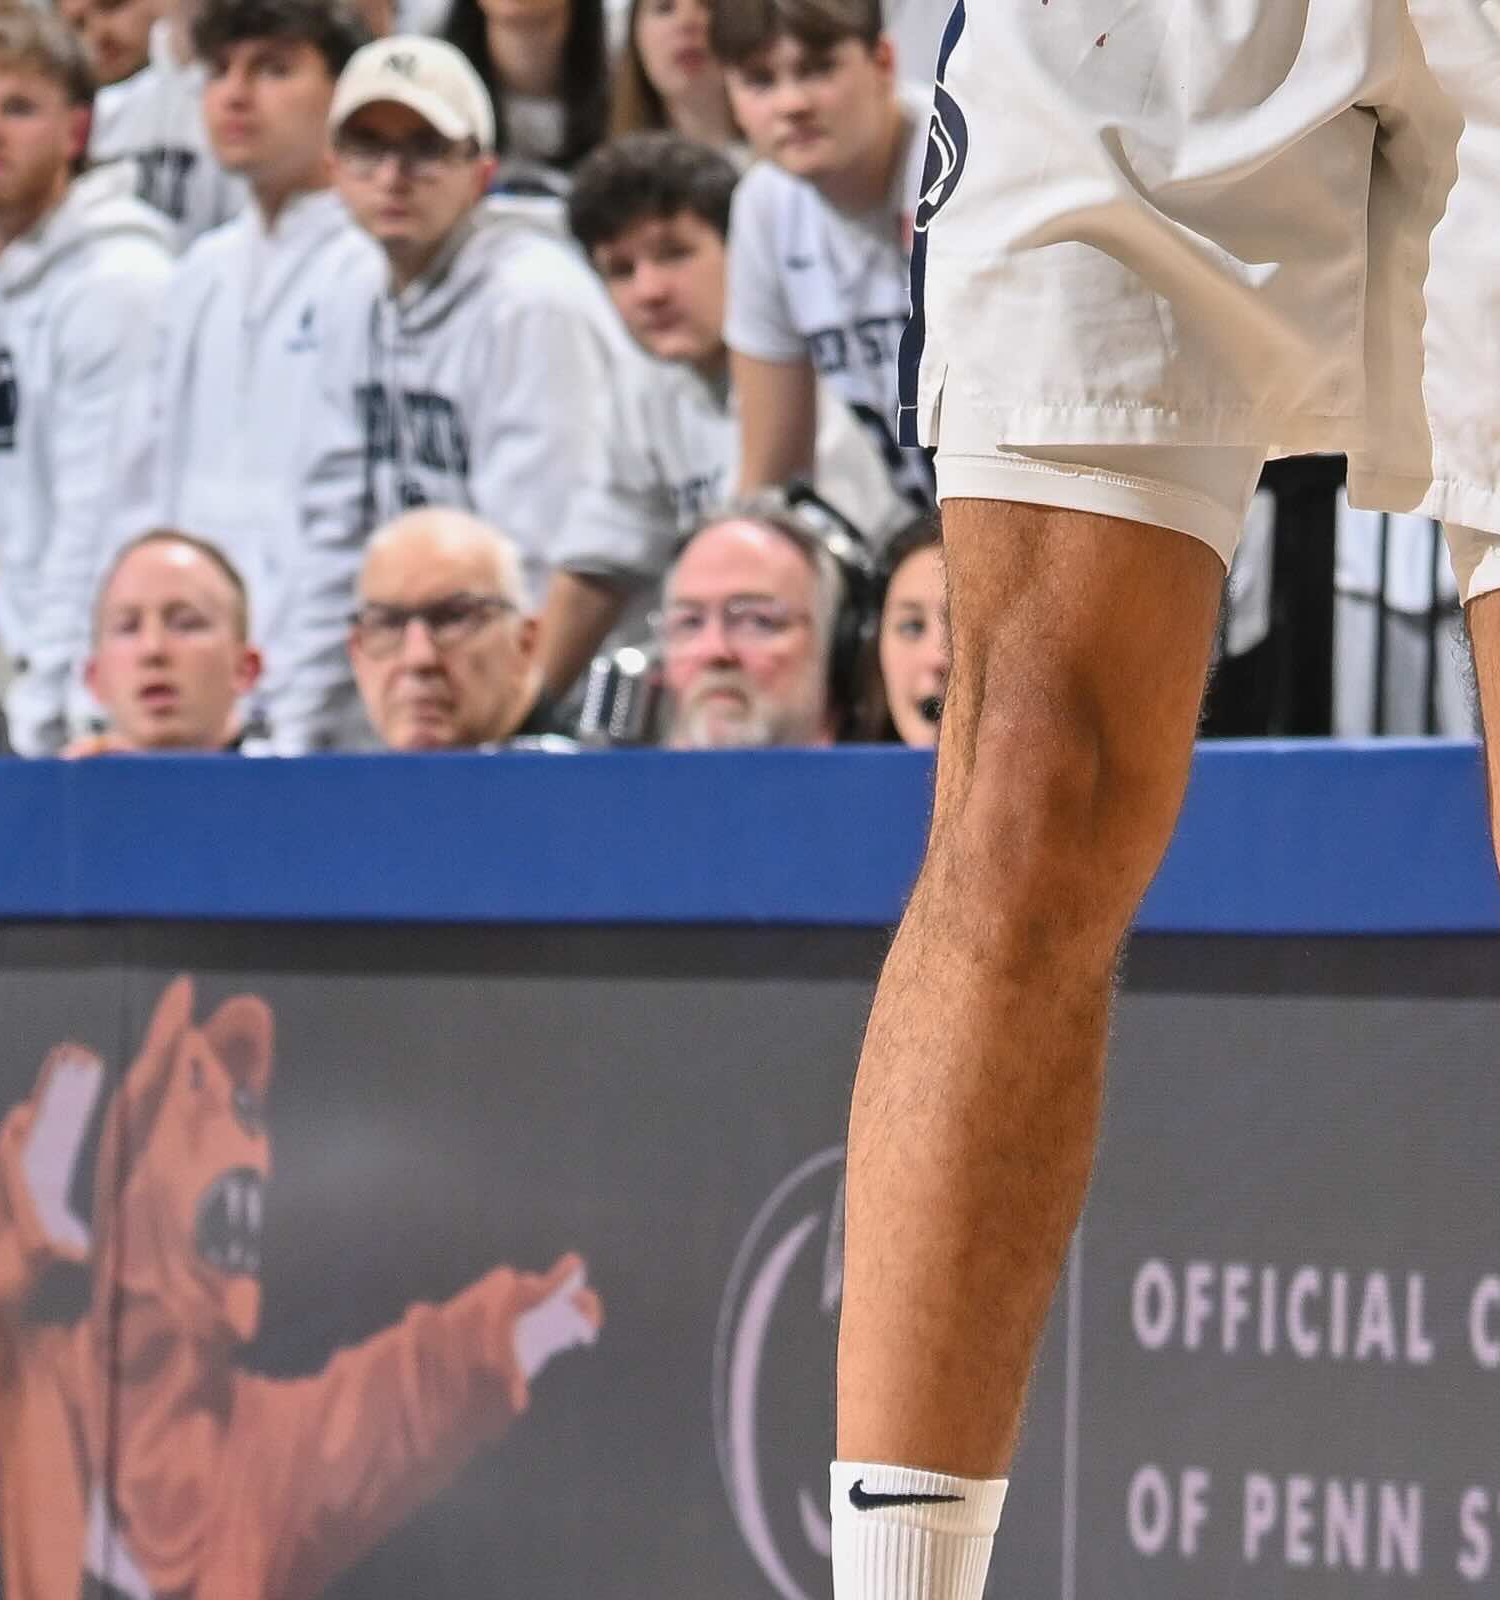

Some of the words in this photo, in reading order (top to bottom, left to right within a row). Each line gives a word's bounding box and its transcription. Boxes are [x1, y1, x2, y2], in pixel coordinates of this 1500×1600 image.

[1130, 1257, 1436, 1366] OFFICIAL
[1126, 1462, 1211, 1557] OF
[1242, 1471, 1426, 1578] PENN
